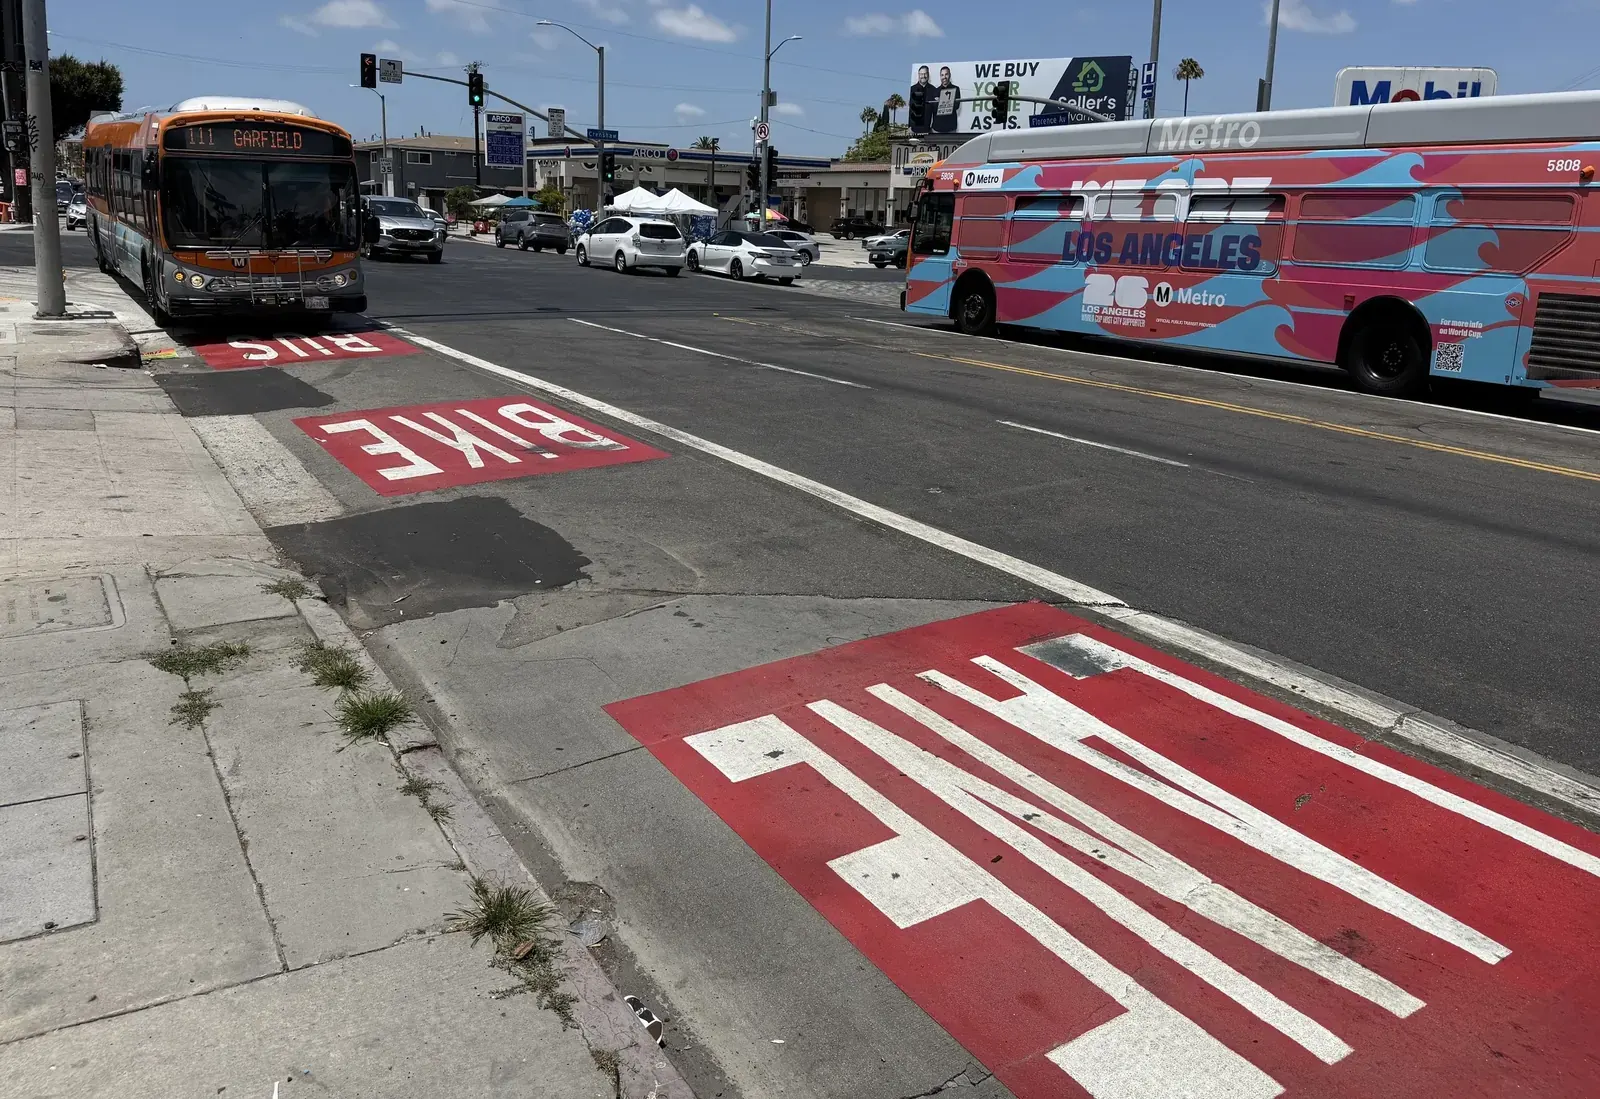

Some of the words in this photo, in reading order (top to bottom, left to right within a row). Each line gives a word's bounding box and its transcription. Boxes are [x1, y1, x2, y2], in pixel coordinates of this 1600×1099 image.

[975, 64, 1000, 78] WE
[1004, 62, 1040, 77] BUY
[1143, 64, 1155, 84] H
[974, 81, 1020, 96] YOR
[972, 99, 1020, 112] HOE
[1058, 95, 1116, 110] Seller's
[1032, 117, 1057, 126] Florence
[189, 128, 214, 145] 111
[234, 128, 302, 149] GARFIELD
[588, 130, 617, 138] Crenshaw
[1158, 117, 1260, 150] Metro
[633, 148, 660, 158] ARCO
[1546, 160, 1581, 172] 5808
[940, 172, 954, 180] 5808
[976, 175, 999, 184] Metro
[1062, 231, 1114, 264] LOS
[1118, 232, 1262, 271] ANGELES
[1083, 273, 1150, 308] 26
[1178, 288, 1226, 307] Metro
[1082, 305, 1100, 314] LOS
[1102, 307, 1146, 318] ANGELES
[1448, 328, 1468, 337] World
[1468, 330, 1482, 339] Cup.
[318, 403, 630, 481] BIKE
[683, 633, 1600, 1099] LANE
